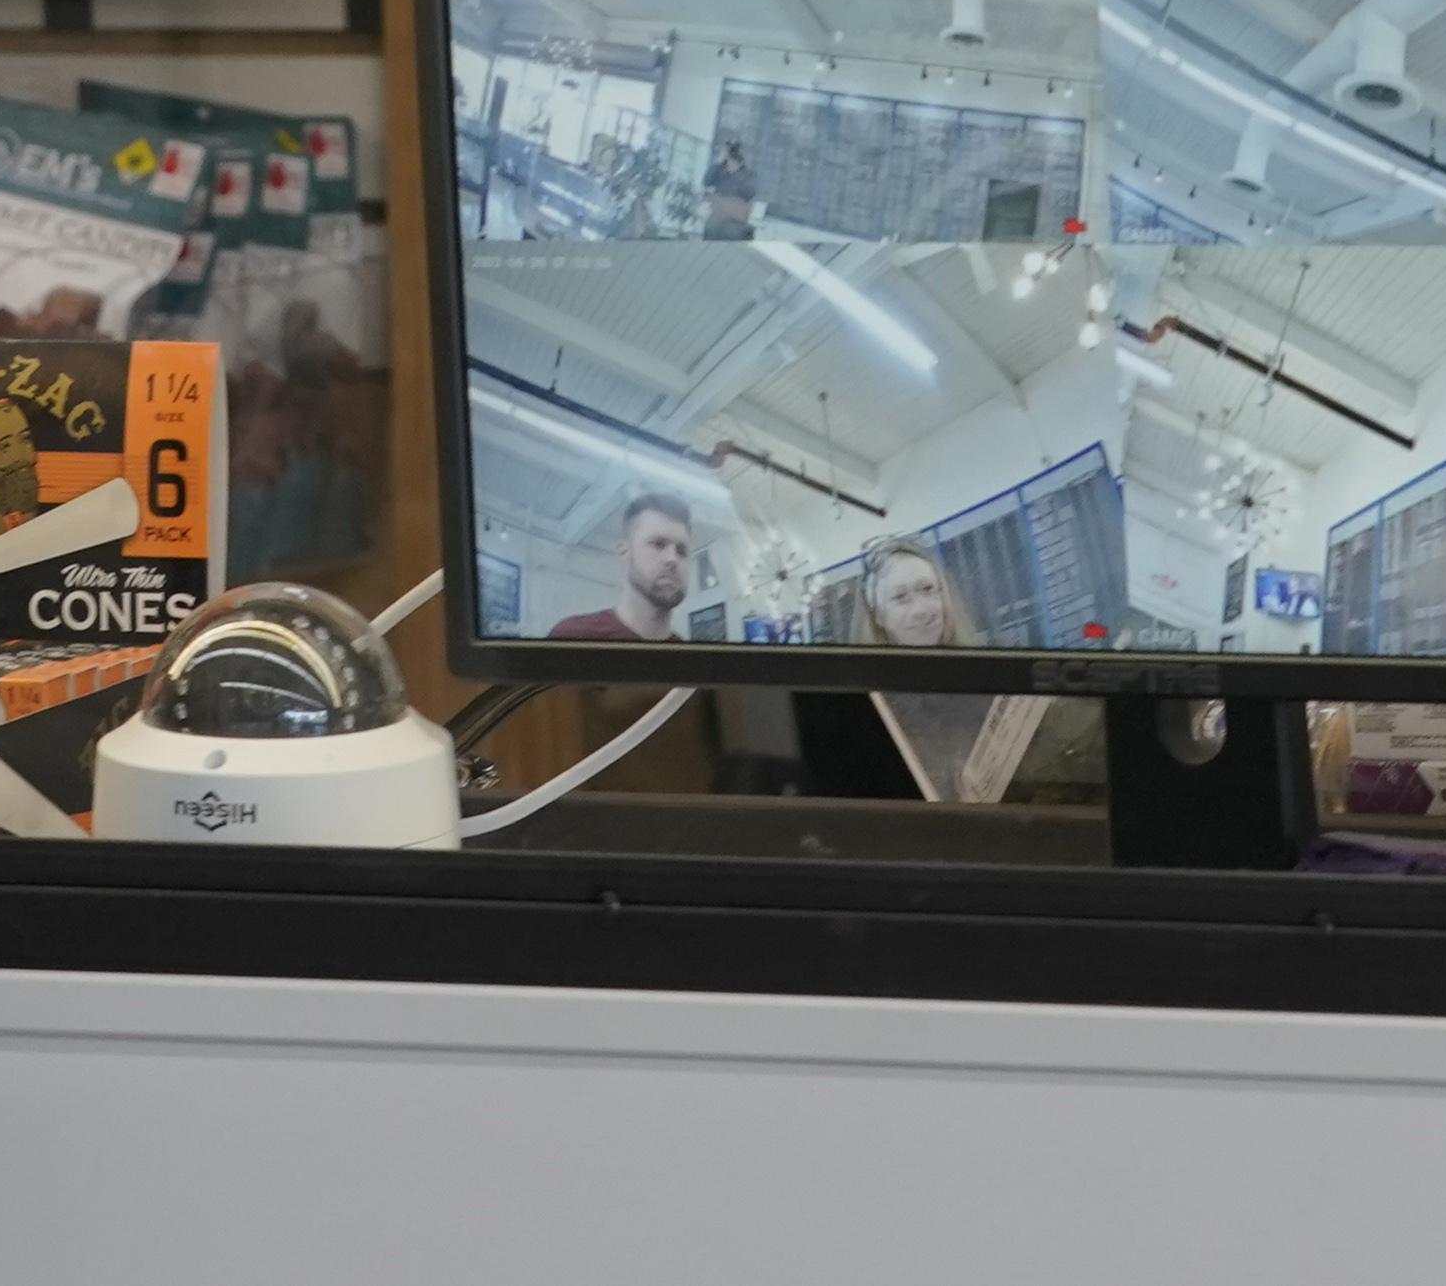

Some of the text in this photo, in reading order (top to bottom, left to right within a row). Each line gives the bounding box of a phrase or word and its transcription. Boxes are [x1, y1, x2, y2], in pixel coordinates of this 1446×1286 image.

[148, 438, 189, 518] 6
[144, 527, 193, 543] PACK
[59, 563, 169, 590] Ultra Thin
[27, 588, 199, 634] CONES
